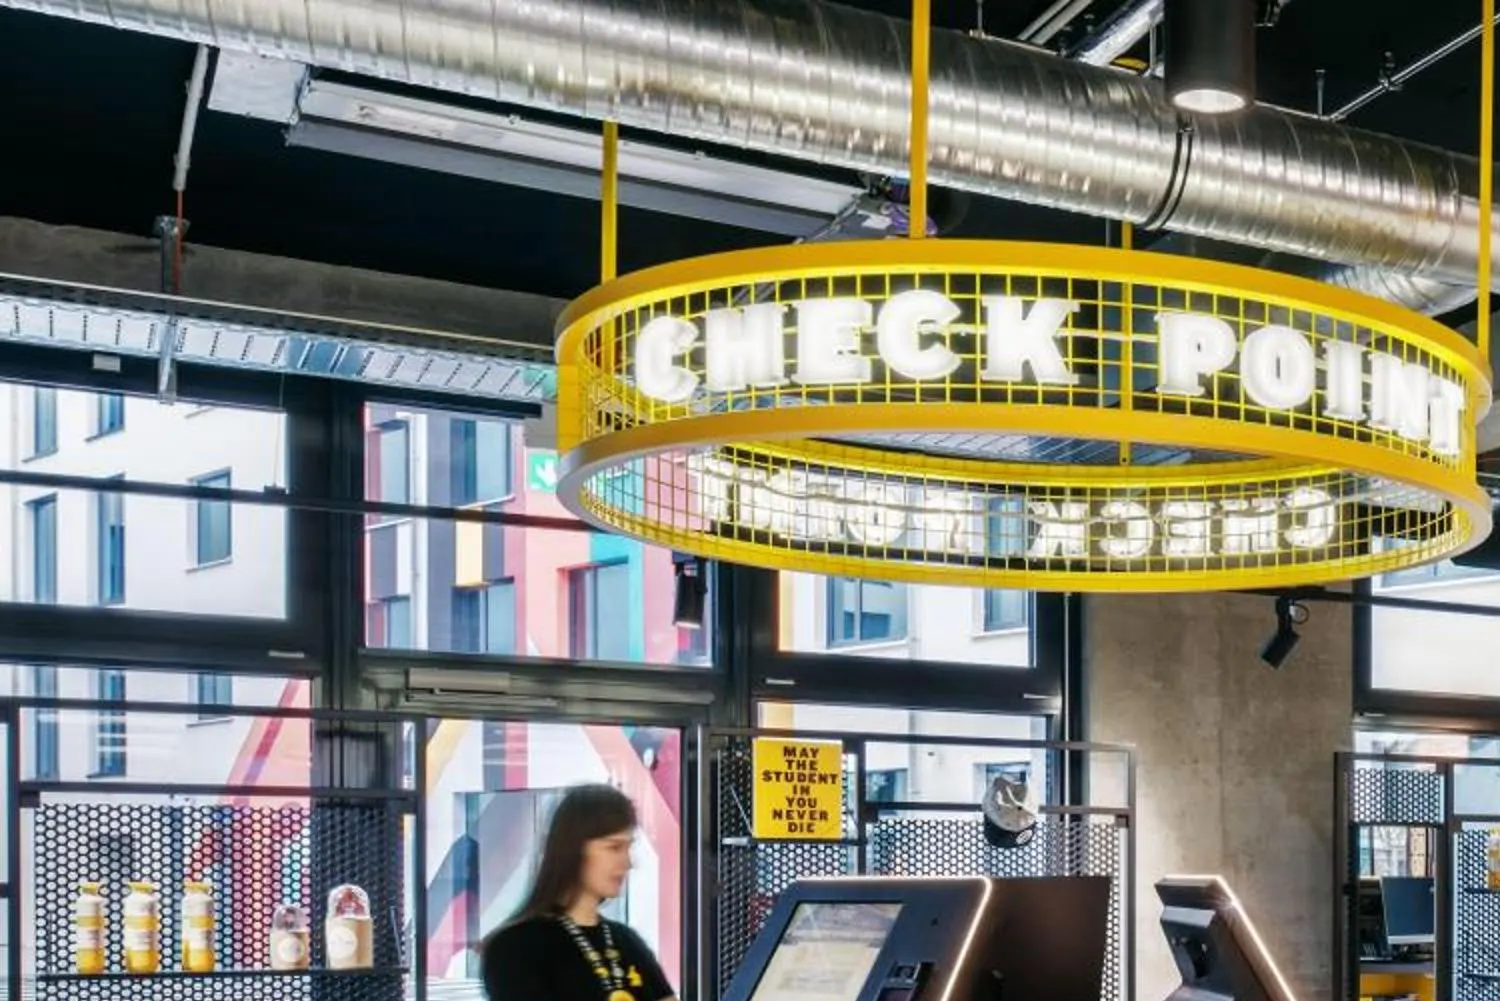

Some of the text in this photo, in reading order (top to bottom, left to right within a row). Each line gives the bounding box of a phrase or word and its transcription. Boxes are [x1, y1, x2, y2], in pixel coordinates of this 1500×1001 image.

[635, 289, 1465, 456] CHECK POINT
[783, 746, 819, 758] MAY
[785, 760, 818, 770] THE
[762, 770, 838, 784] STUDENT
[793, 785, 810, 795] IN
[786, 797, 817, 808] YOU
[772, 810, 829, 821] NEVER
[788, 822, 815, 833] DIE
